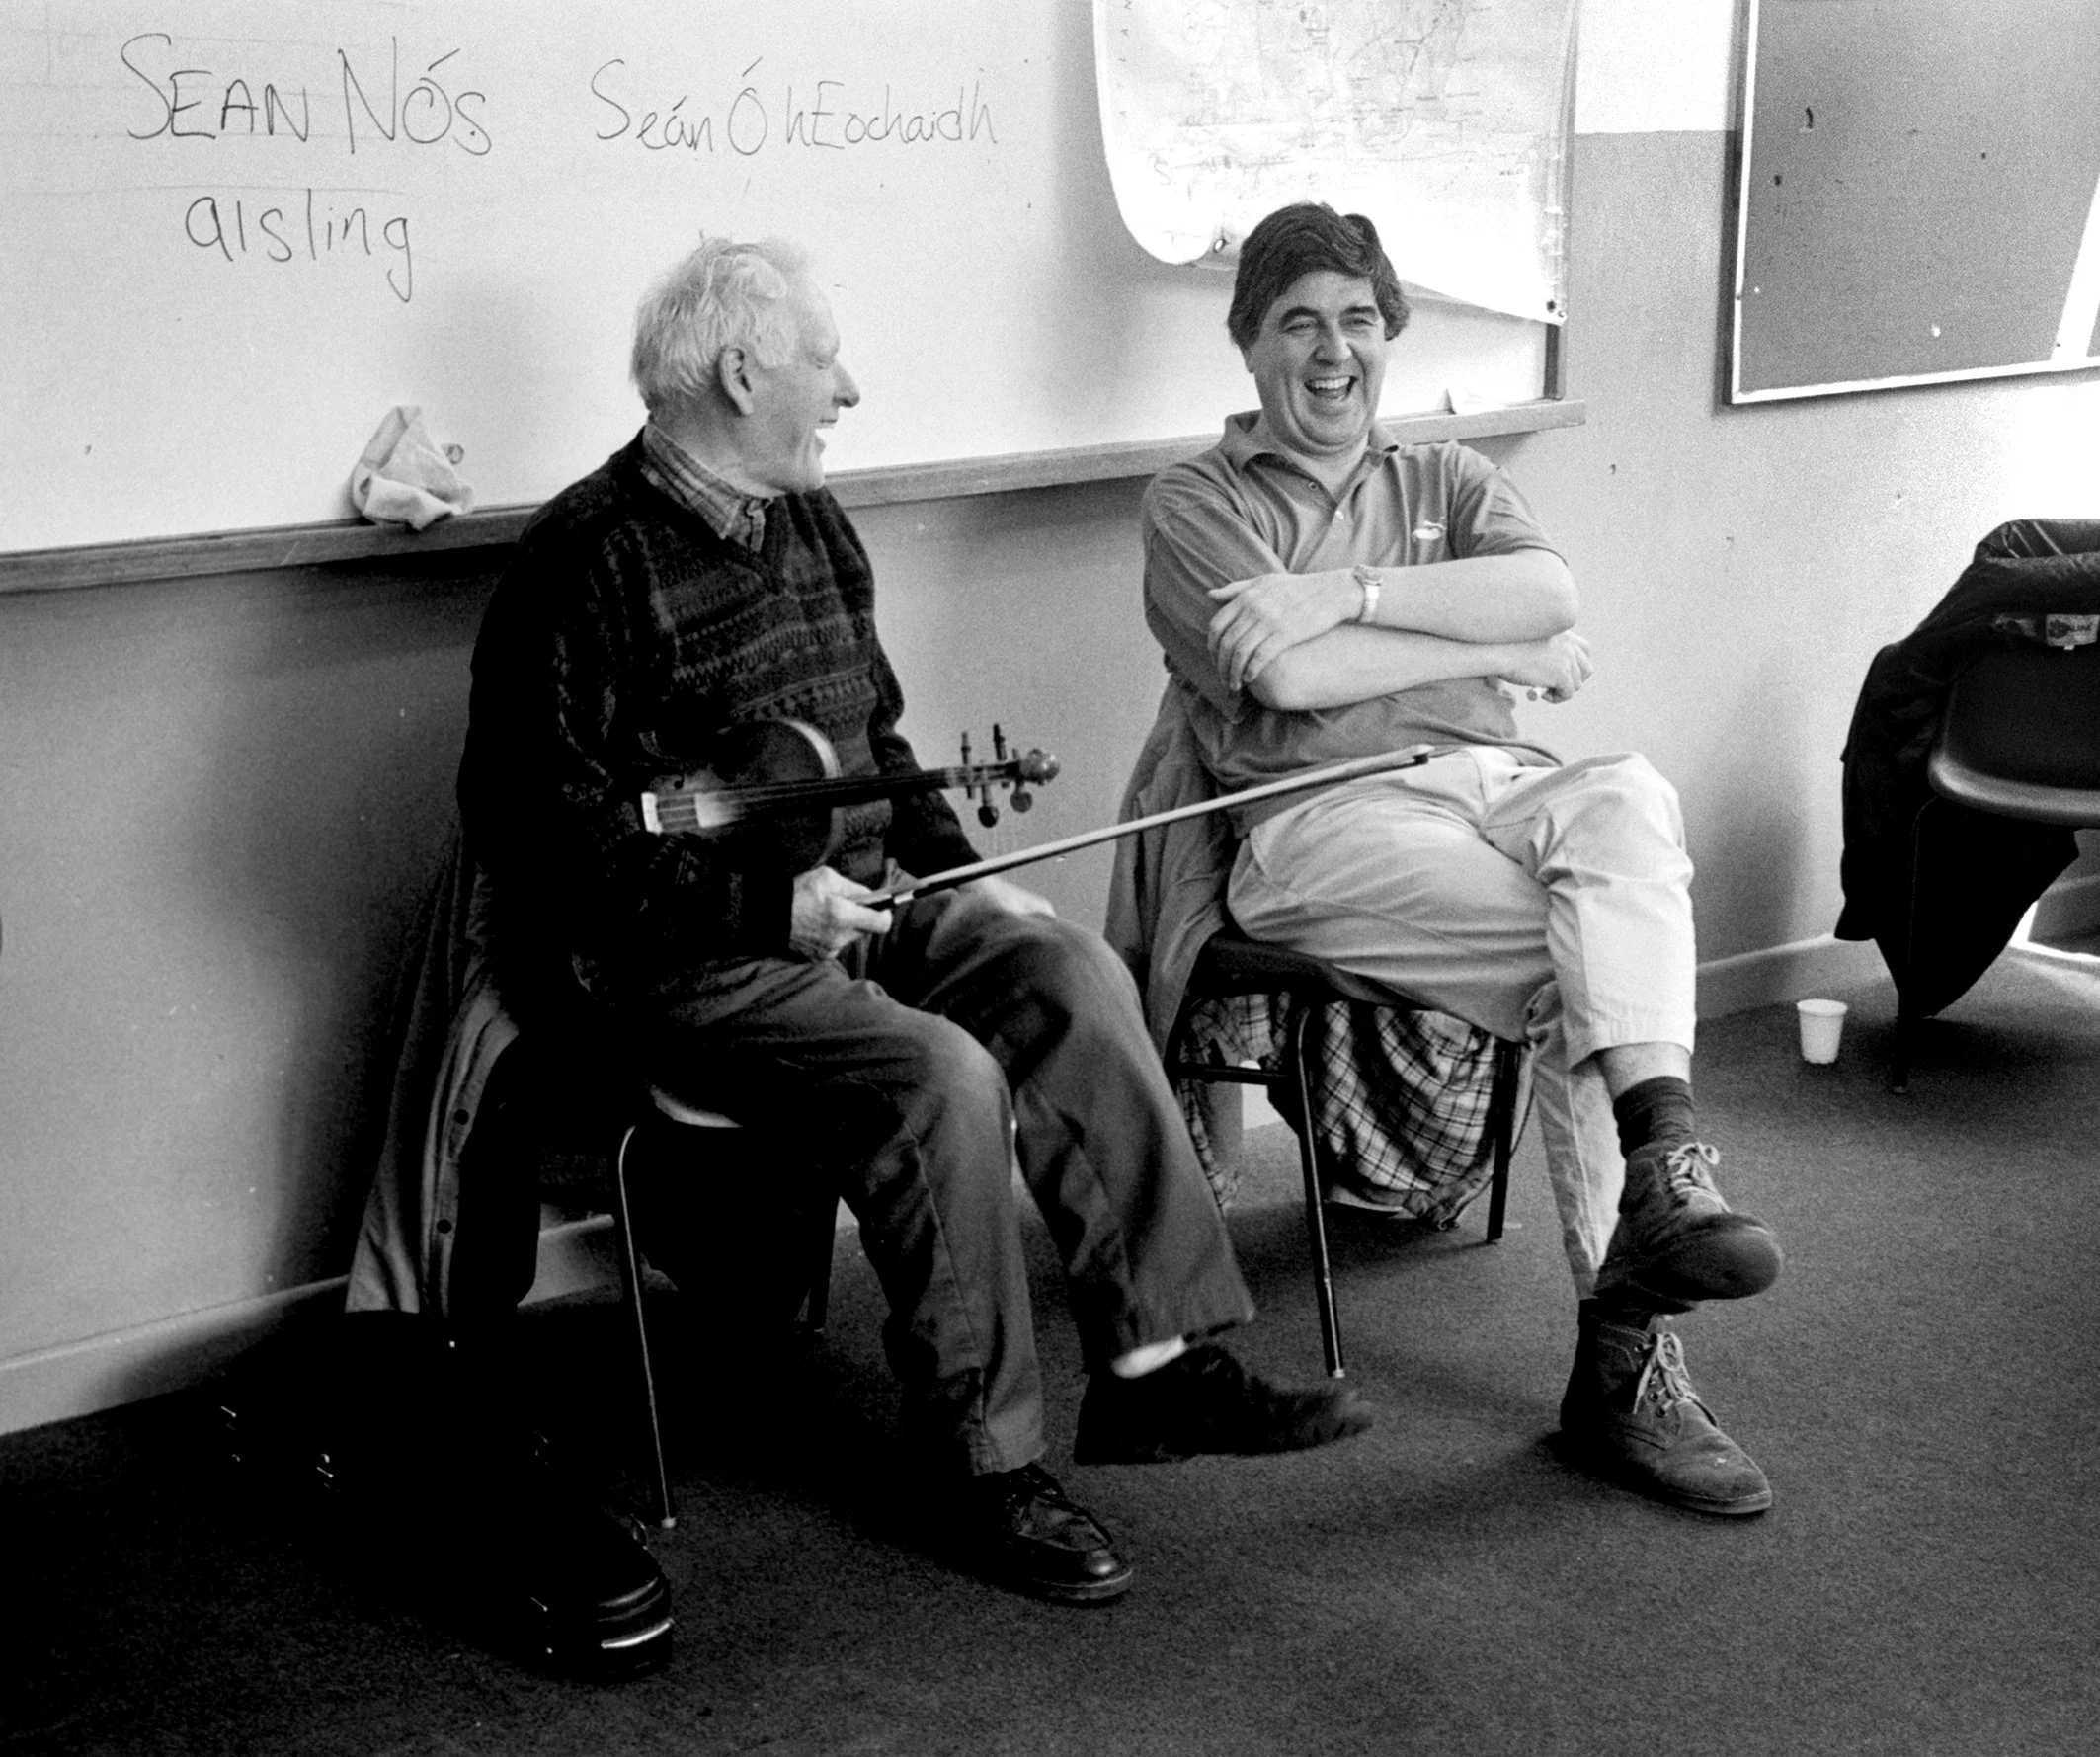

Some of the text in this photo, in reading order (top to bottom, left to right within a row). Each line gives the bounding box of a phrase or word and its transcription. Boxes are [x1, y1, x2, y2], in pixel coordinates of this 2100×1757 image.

[120, 32, 493, 156] SEAN NÓS
[590, 55, 999, 157] Seán Ó hEochaidh
